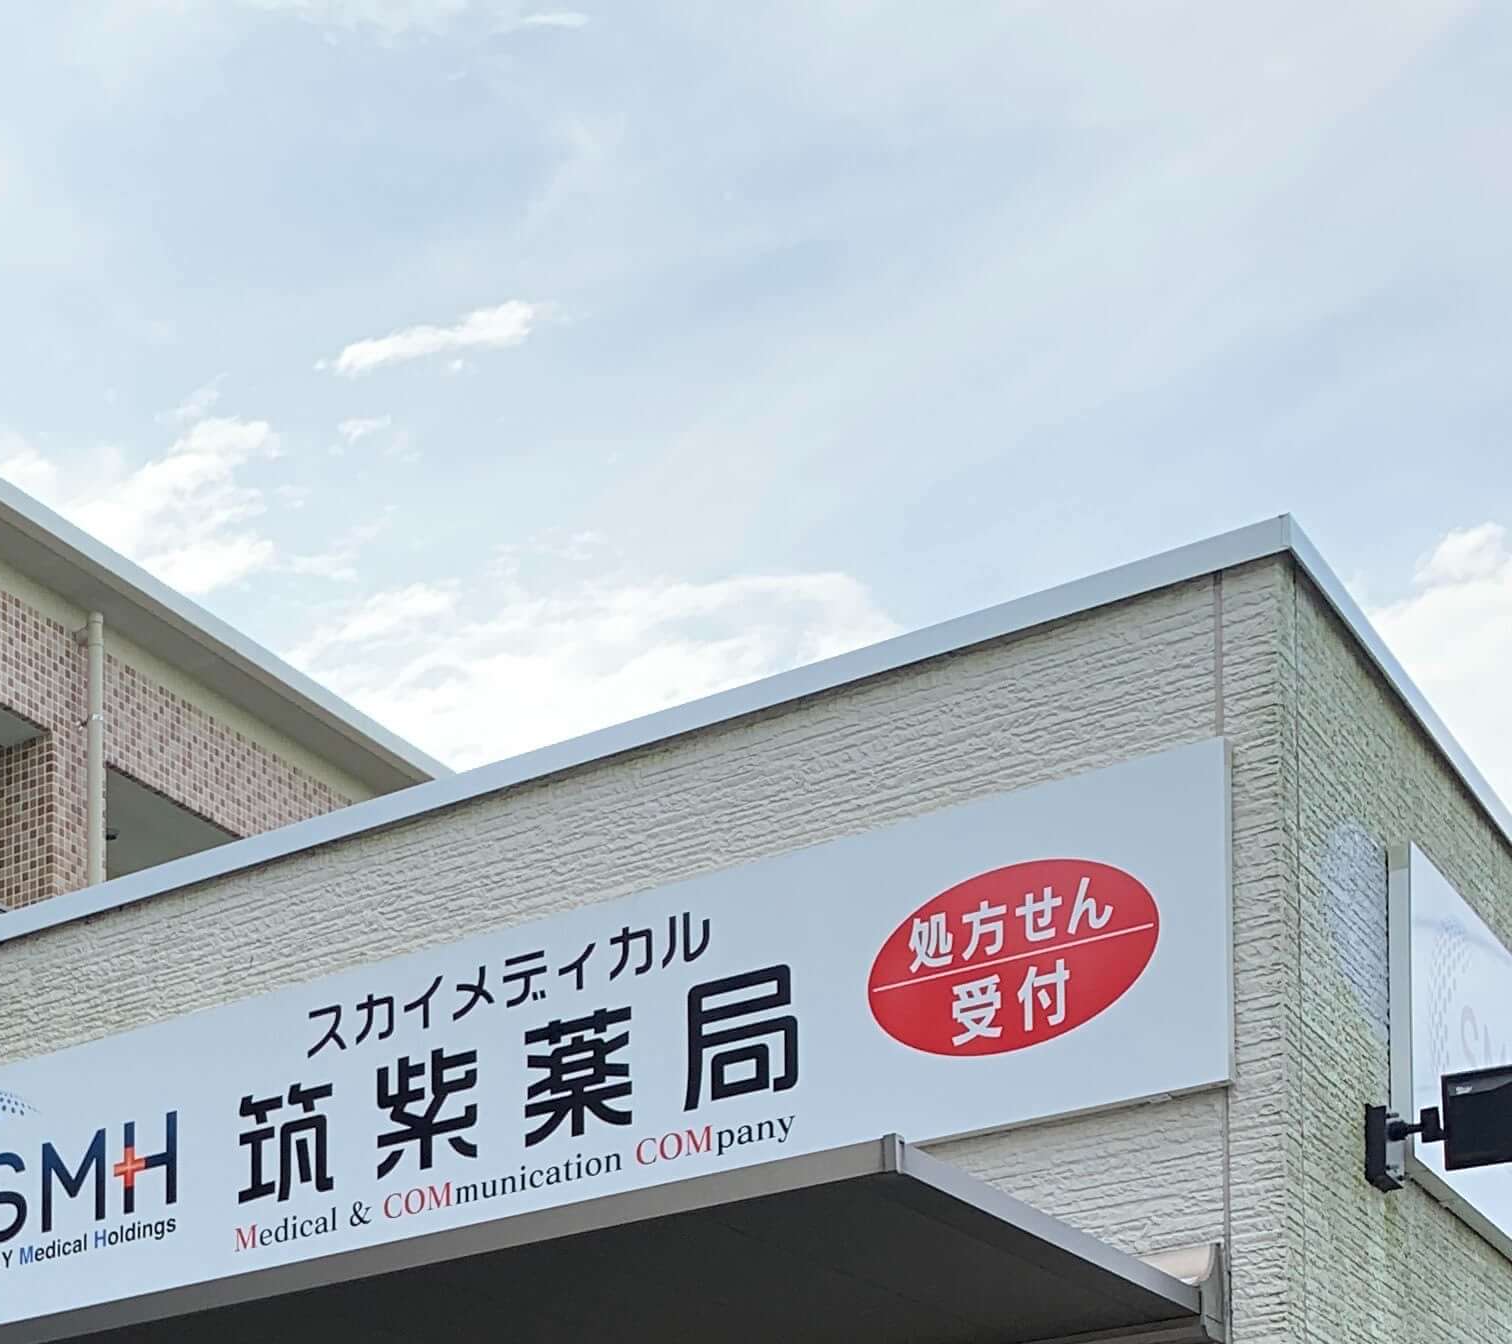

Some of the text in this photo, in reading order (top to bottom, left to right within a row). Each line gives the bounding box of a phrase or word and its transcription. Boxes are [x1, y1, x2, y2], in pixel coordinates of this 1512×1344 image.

[908, 877, 1114, 973] 処方せん
[307, 911, 711, 1058] スカイメディカル
[951, 958, 1070, 1047] 受付
[238, 964, 798, 1204] 筑紫薬局
[19, 1234, 87, 1265] Medical
[94, 1218, 176, 1248] Holdings
[234, 1115, 796, 1252] Medical & COMmunication COMpany
